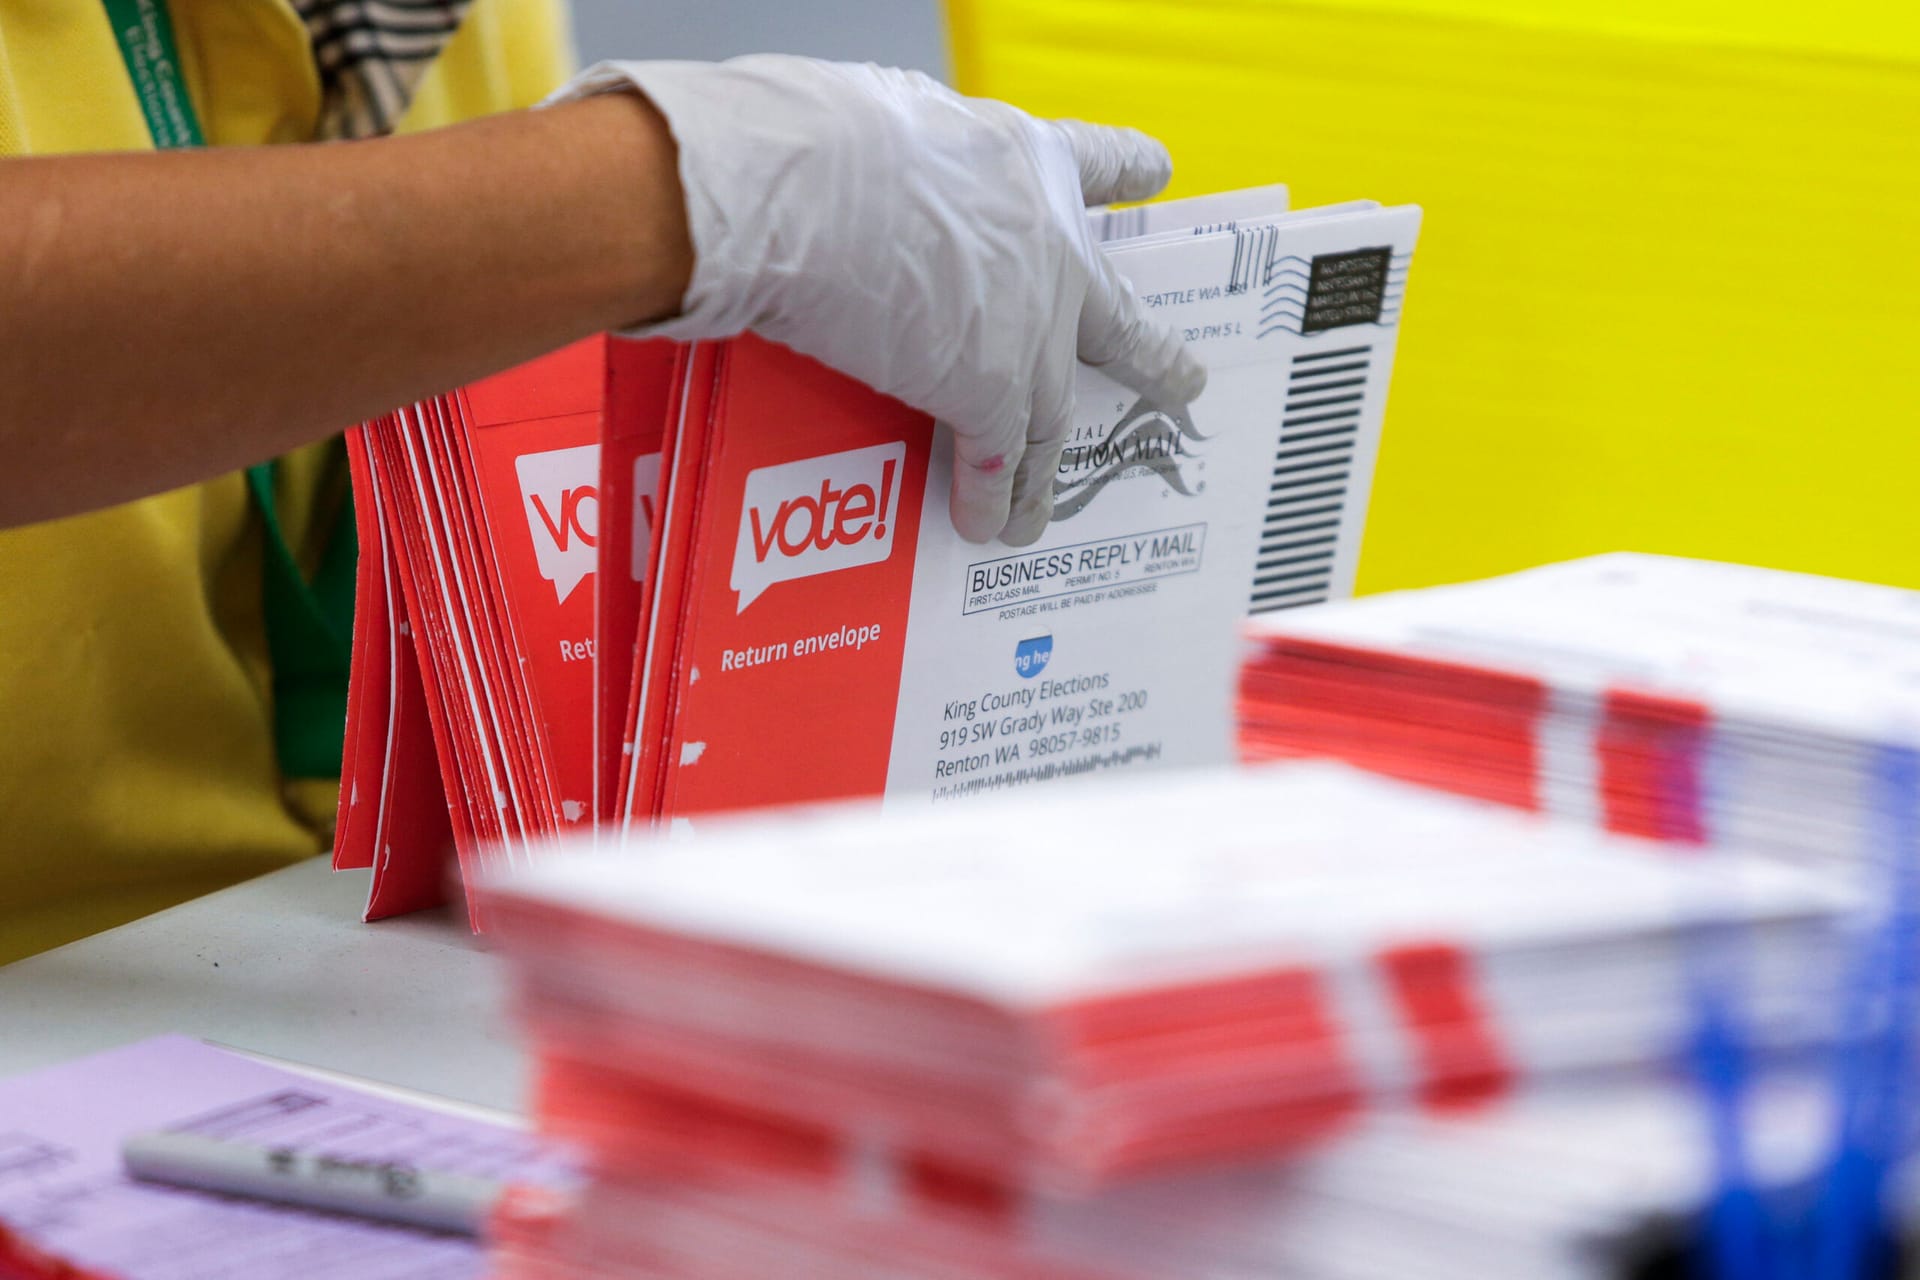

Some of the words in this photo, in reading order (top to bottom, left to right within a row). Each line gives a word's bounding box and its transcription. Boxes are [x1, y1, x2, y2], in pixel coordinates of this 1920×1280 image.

[1199, 286, 1221, 300] WA
[1202, 325, 1221, 339] PM
[1131, 430, 1184, 462] MAIL
[749, 459, 897, 564] vote!
[972, 553, 1074, 593] BUSINESS
[1079, 539, 1147, 572] REPLY
[1150, 533, 1196, 559] MAIL
[969, 588, 1020, 607] FIRST-CLASS
[1022, 585, 1041, 597] MAIL
[1065, 572, 1097, 588] PERMIT
[999, 604, 1038, 620] POSTAGE
[1040, 601, 1059, 613] WILL
[1061, 598, 1072, 608] BE
[1074, 593, 1094, 606] PAID
[1096, 592, 1106, 602] BY
[560, 637, 597, 662] Ret
[721, 641, 788, 672] Return
[793, 623, 881, 659] envelope
[944, 699, 977, 721] King
[981, 687, 1036, 709] County
[1040, 672, 1110, 700] Elections
[940, 726, 967, 750] 919
[971, 719, 998, 743] SW
[1000, 710, 1047, 735] Grady
[1052, 705, 1085, 726] Way
[1087, 698, 1113, 718] Ste
[1118, 689, 1148, 713] 200
[935, 753, 990, 779] Renton
[995, 743, 1020, 765] WA
[1029, 721, 1120, 758] 98057-9815
